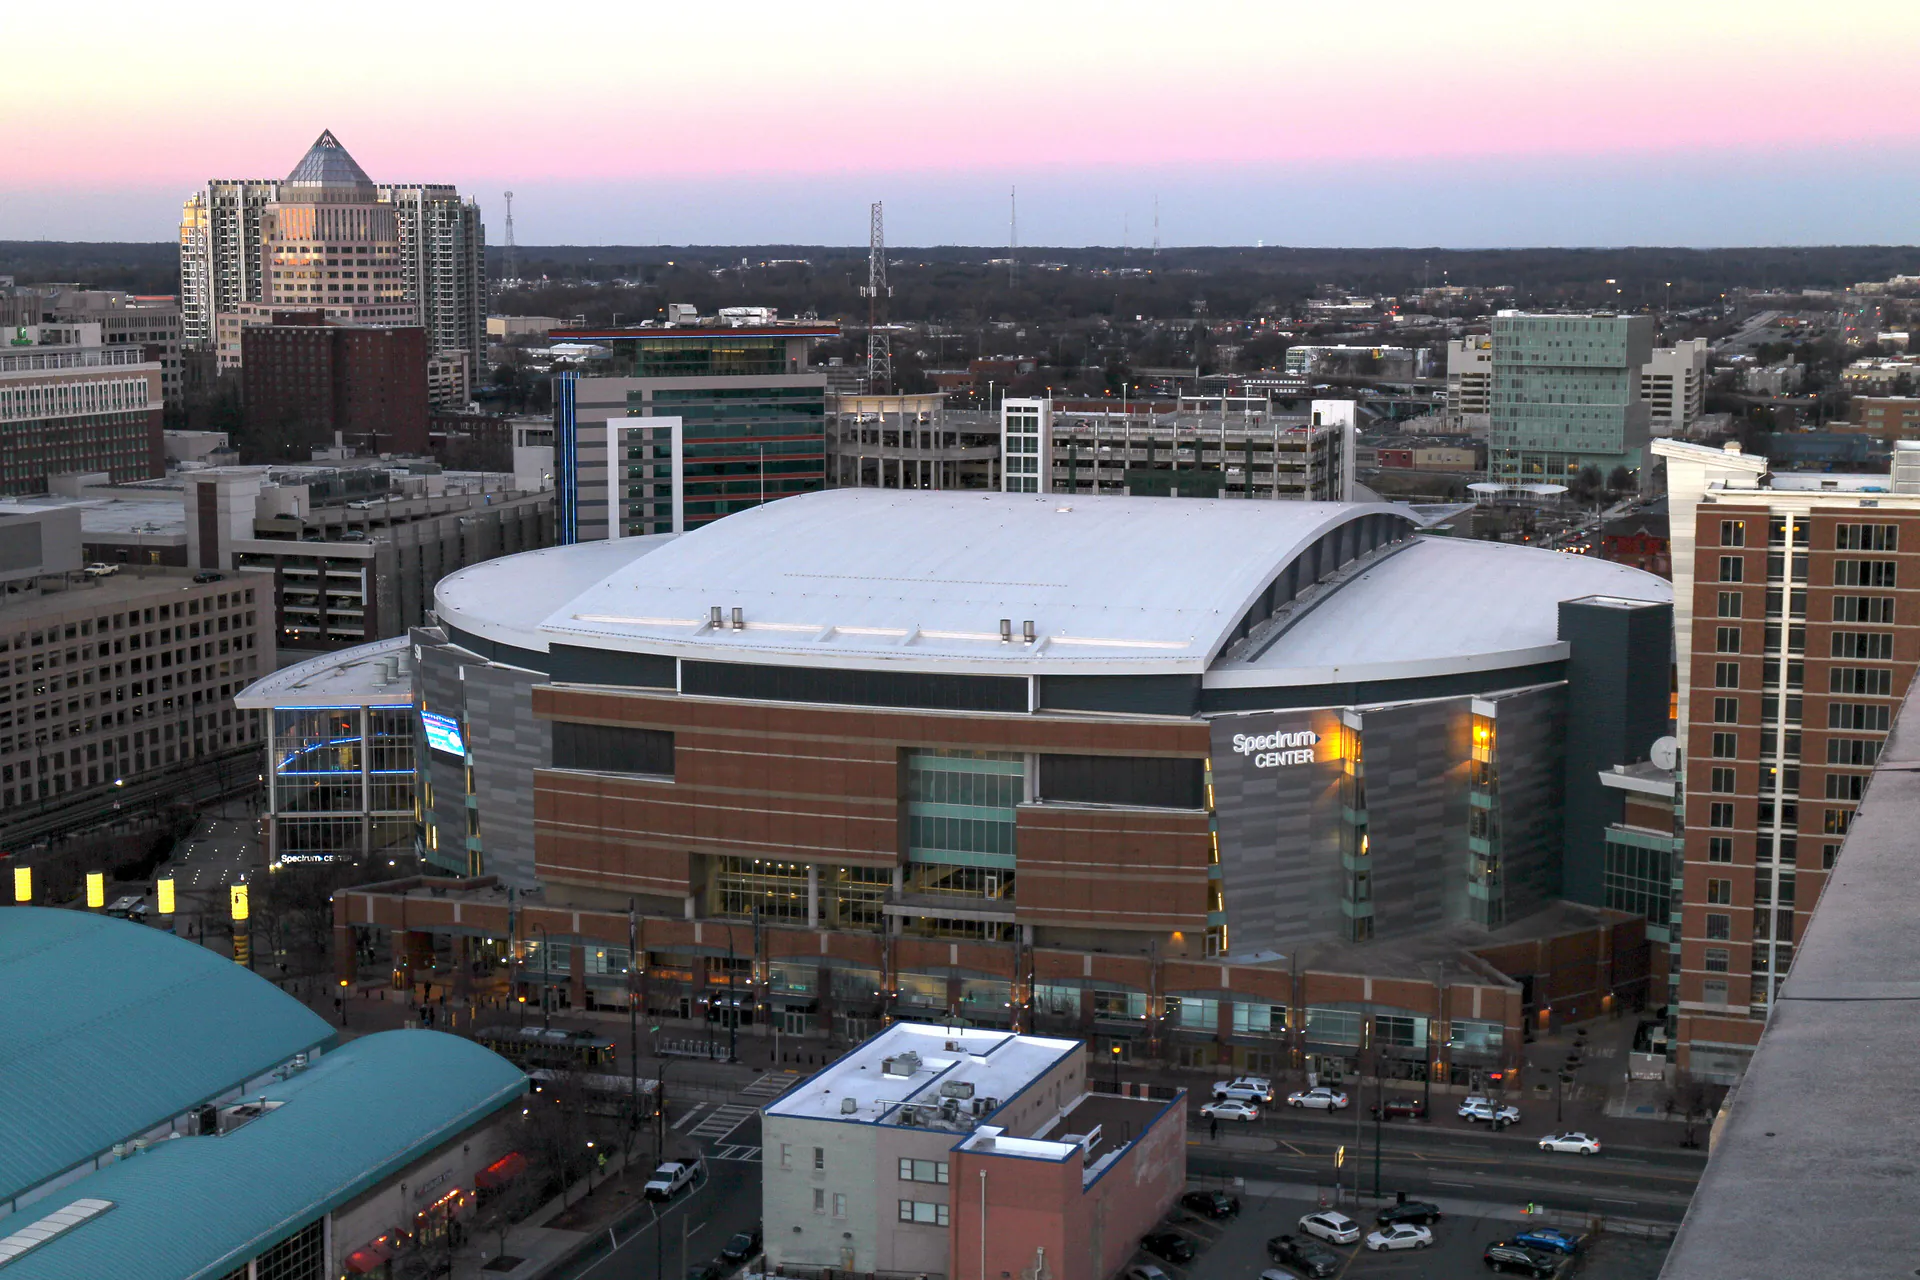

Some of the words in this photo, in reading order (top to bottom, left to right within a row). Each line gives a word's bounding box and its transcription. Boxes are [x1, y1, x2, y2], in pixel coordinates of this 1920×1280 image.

[1233, 730, 1316, 756] Spectrum
[1255, 749, 1315, 768] CENTER
[281, 854, 321, 864] Spectrum
[323, 854, 352, 862] CETER
